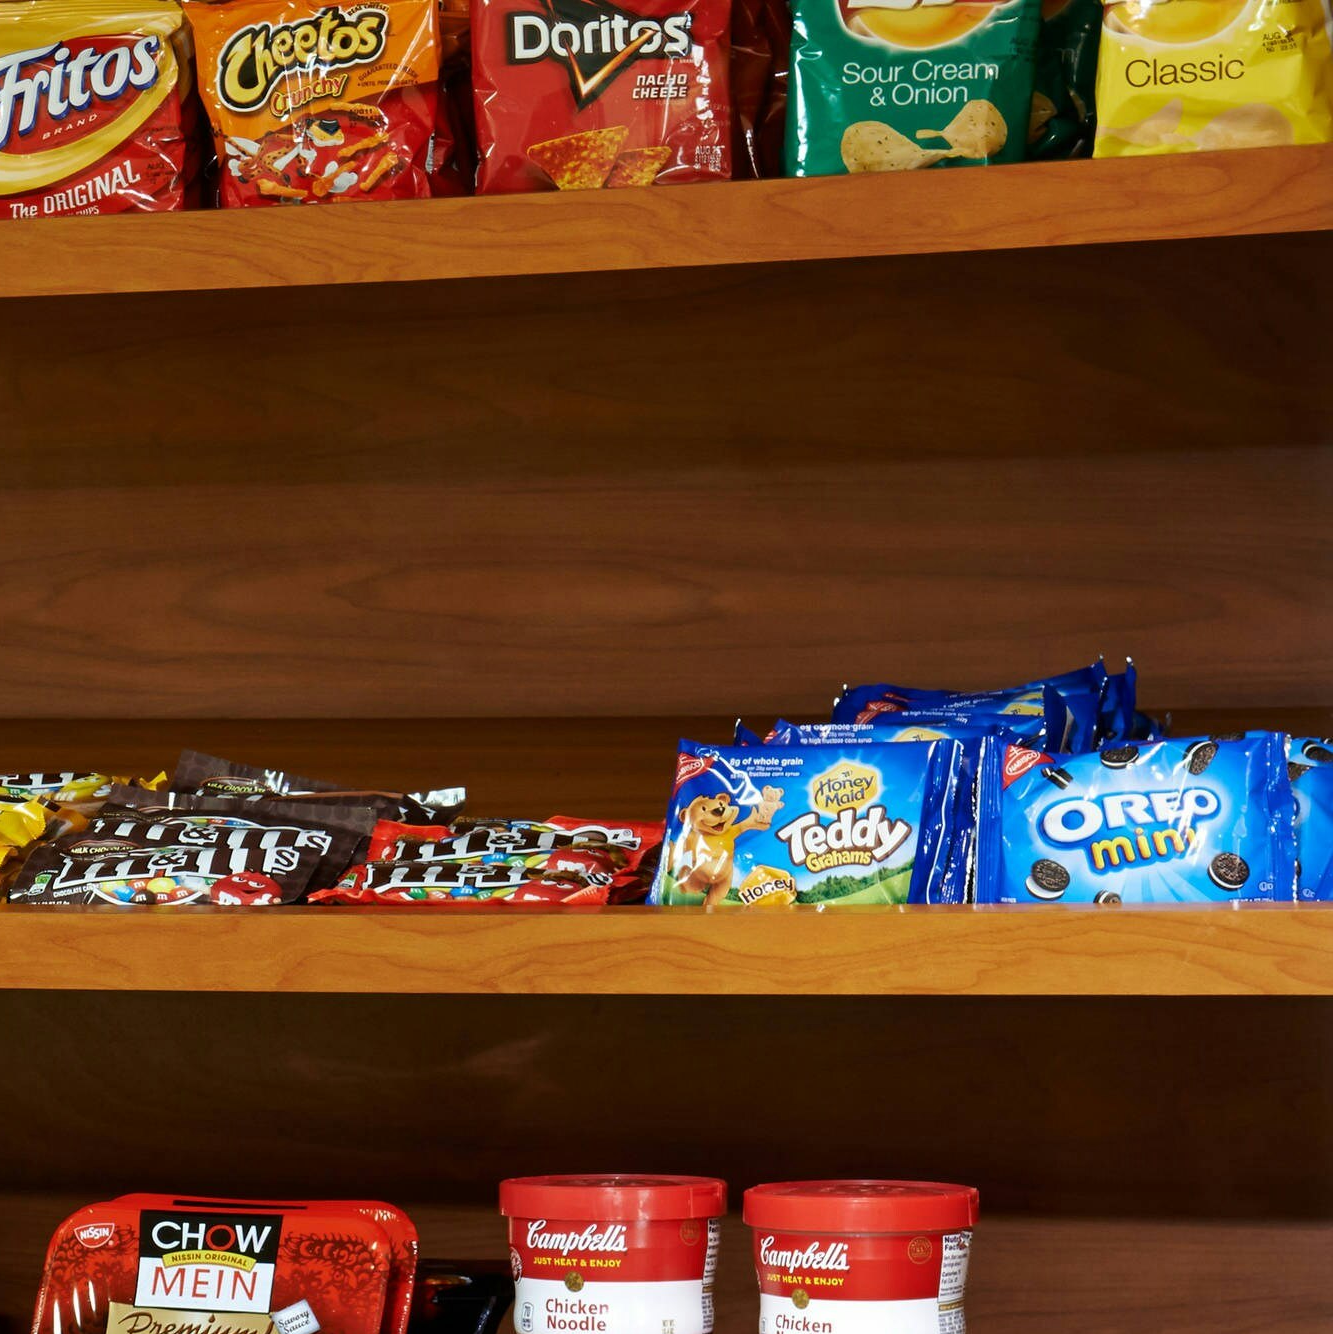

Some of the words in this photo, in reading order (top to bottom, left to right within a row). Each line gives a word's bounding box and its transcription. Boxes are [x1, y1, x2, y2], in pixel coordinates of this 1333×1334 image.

[514, 14, 691, 59] Doritos
[222, 9, 382, 105] Cheetos
[636, 73, 688, 87] NACHO
[842, 62, 904, 84] Sour
[912, 59, 999, 81] Cream
[1125, 54, 1245, 88] Classic
[271, 73, 349, 115] Crunchy
[632, 86, 688, 99] CHEESE
[870, 87, 886, 106] &
[892, 83, 968, 105] Onion
[42, 113, 98, 140] BRAND
[10, 203, 38, 219] The
[43, 160, 141, 214] ORIGINAL
[742, 757, 752, 766] of
[753, 757, 780, 766] whole
[782, 758, 804, 767] grain
[816, 775, 875, 796] Honey
[825, 788, 865, 809] Maid
[1043, 788, 1219, 843] OREO
[778, 807, 912, 864] Teddy
[804, 850, 873, 872] Grahams
[741, 876, 795, 905] Honey
[80, 1226, 110, 1239] NISSIN
[151, 1221, 272, 1254] CHOW
[526, 1219, 628, 1256] Campbell's
[171, 1254, 202, 1263] NISSIN
[205, 1253, 248, 1267] ORIGINAL
[533, 1257, 552, 1265] JUST
[554, 1258, 577, 1267] HEAT
[580, 1259, 587, 1267] &
[589, 1259, 621, 1268] ENJOY
[760, 1235, 850, 1273] Campbell's
[151, 1266, 258, 1300] MEIN
[545, 1298, 609, 1314] Chicken
[546, 1316, 607, 1331] Noodle
[775, 1314, 832, 1333] Chicken
